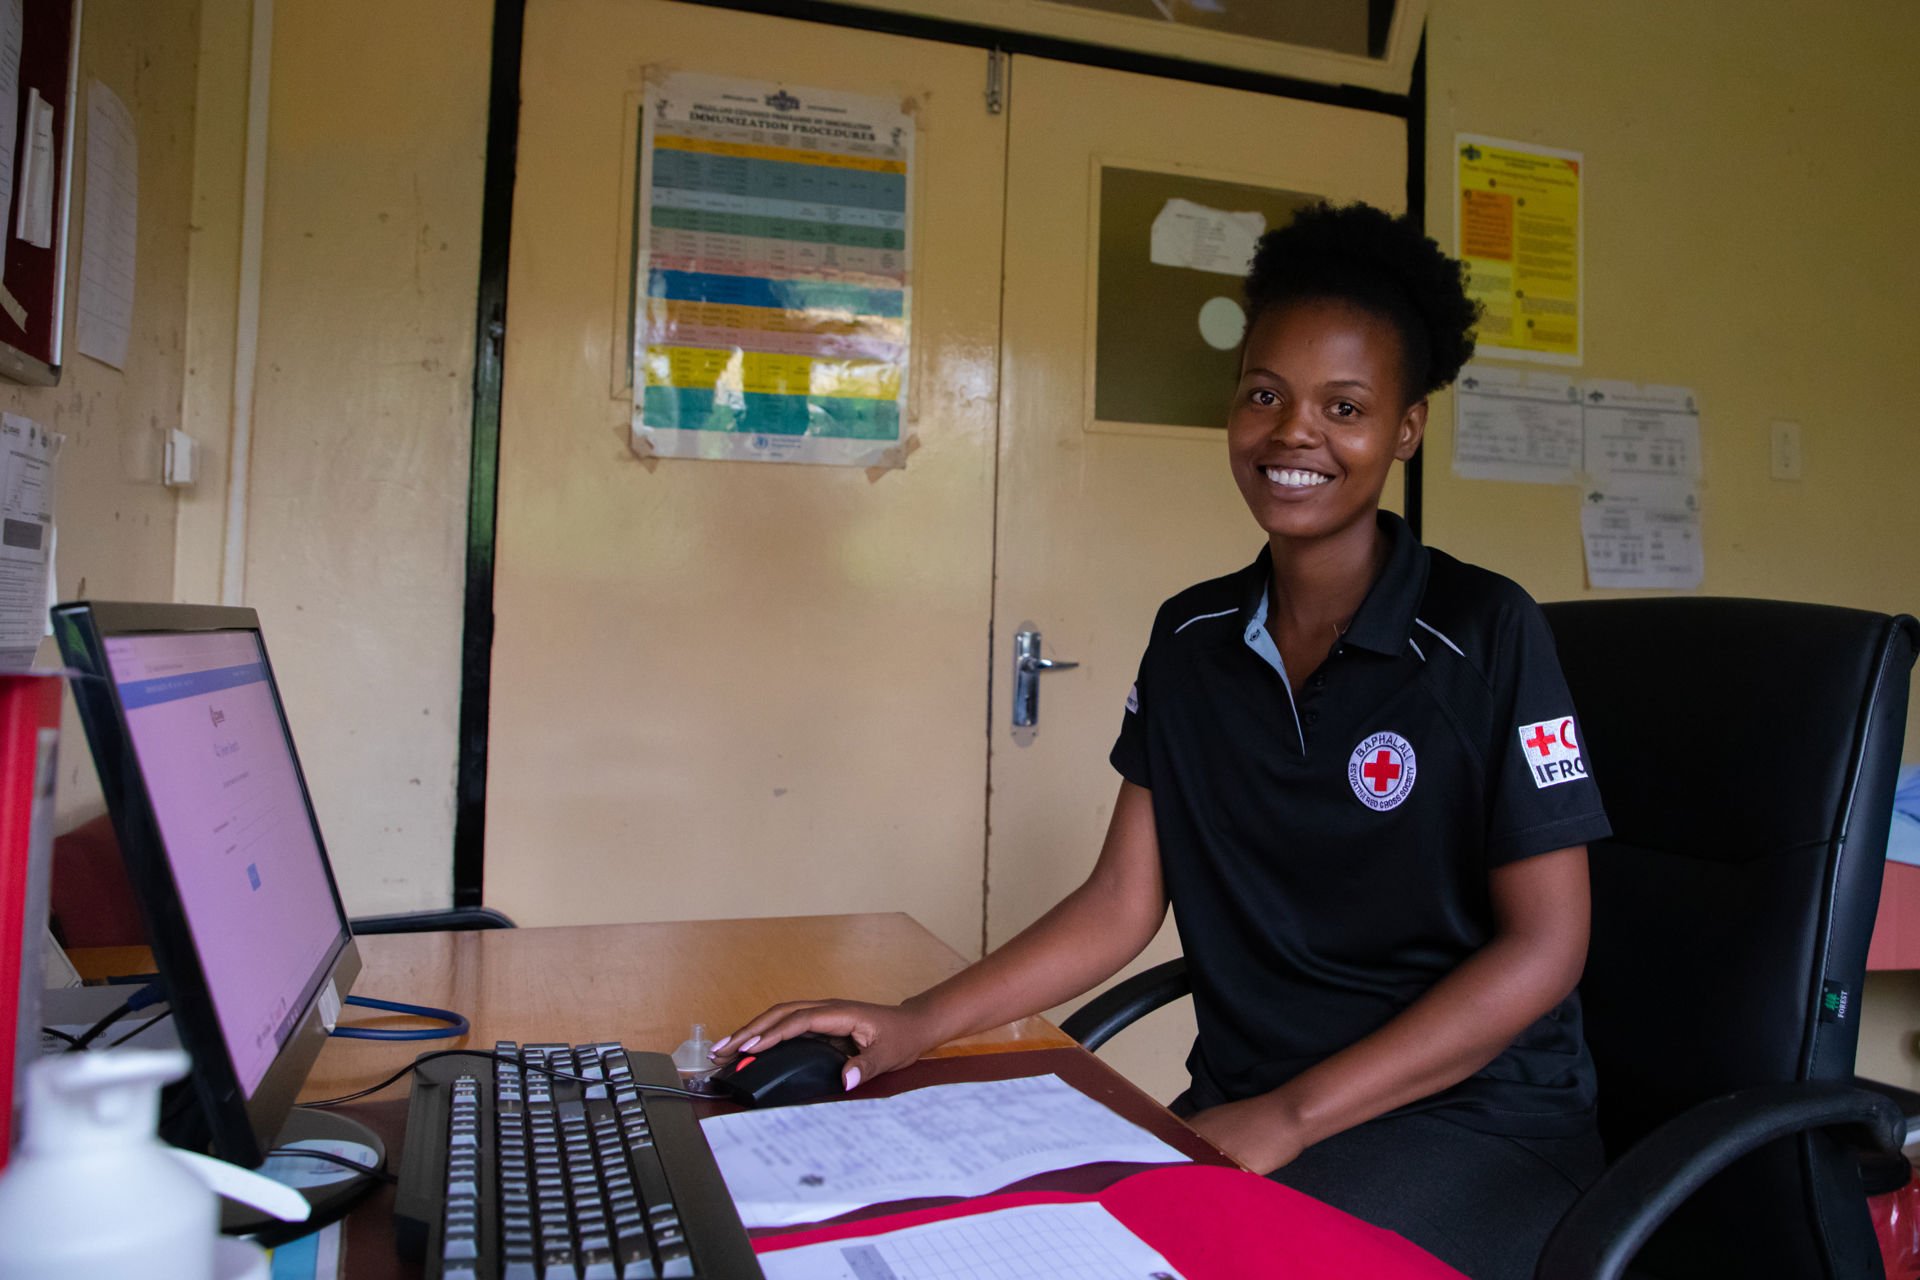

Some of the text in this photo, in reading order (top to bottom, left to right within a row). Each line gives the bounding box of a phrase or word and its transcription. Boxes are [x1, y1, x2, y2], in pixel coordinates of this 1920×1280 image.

[689, 111, 875, 141] IMMUNIZATION PROCEDURES
[1355, 734, 1413, 761] BAPHALALI
[1366, 796, 1379, 808] RED
[1379, 794, 1402, 809] CROSS
[1400, 765, 1415, 797] SOCIETY
[1837, 990, 1848, 1018] FOREST
